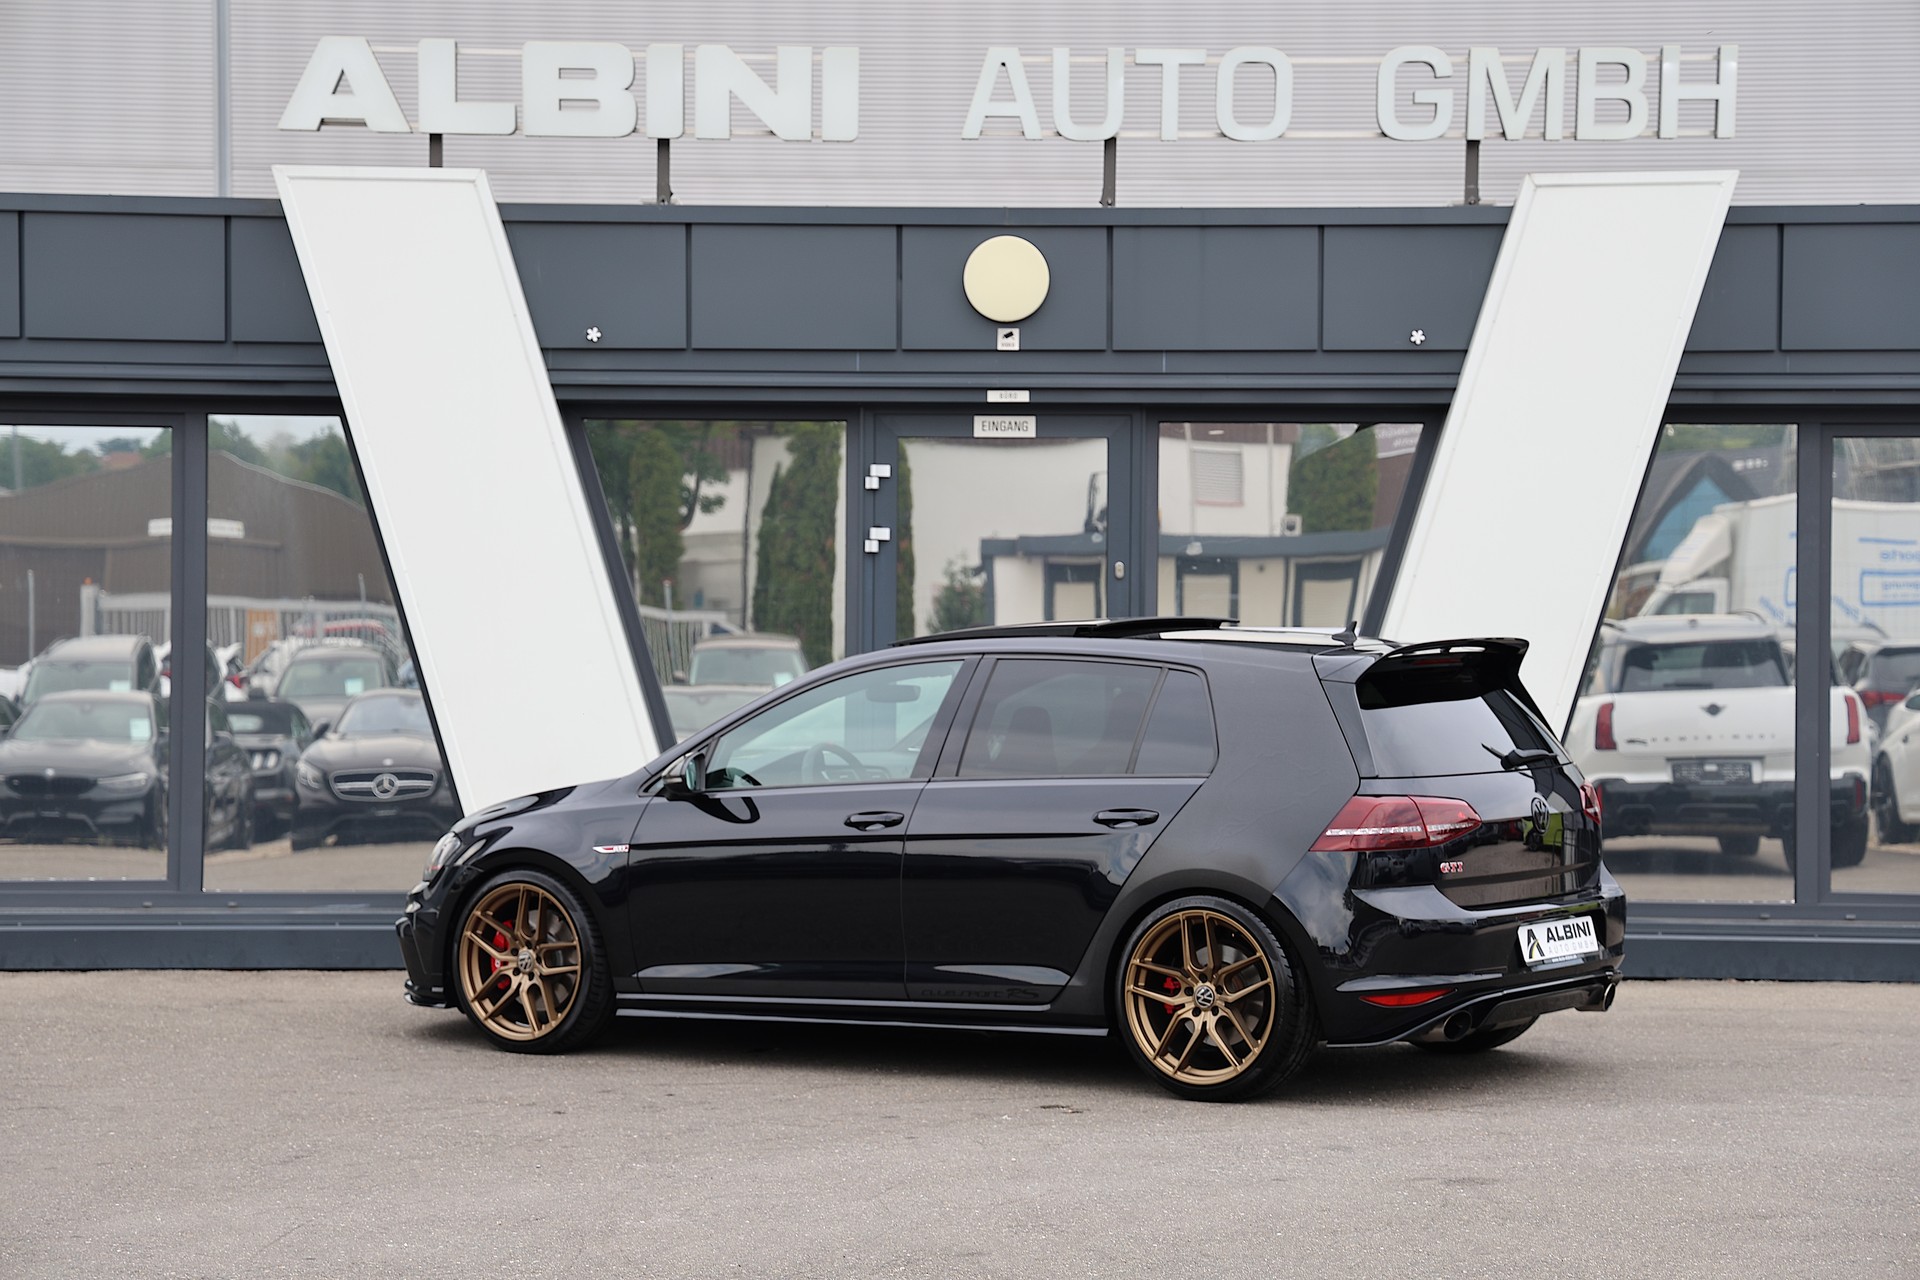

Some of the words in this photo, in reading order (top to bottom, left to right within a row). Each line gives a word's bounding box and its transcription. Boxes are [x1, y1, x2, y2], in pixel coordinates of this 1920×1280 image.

[278, 36, 860, 142] ALBINI
[961, 46, 1294, 142] AUTO
[1376, 44, 1739, 142] GMBH
[981, 420, 1029, 432] EINGANG
[1440, 861, 1463, 874] GTI
[1546, 920, 1592, 944] ALBINI
[1548, 943, 1570, 954] AUTO
